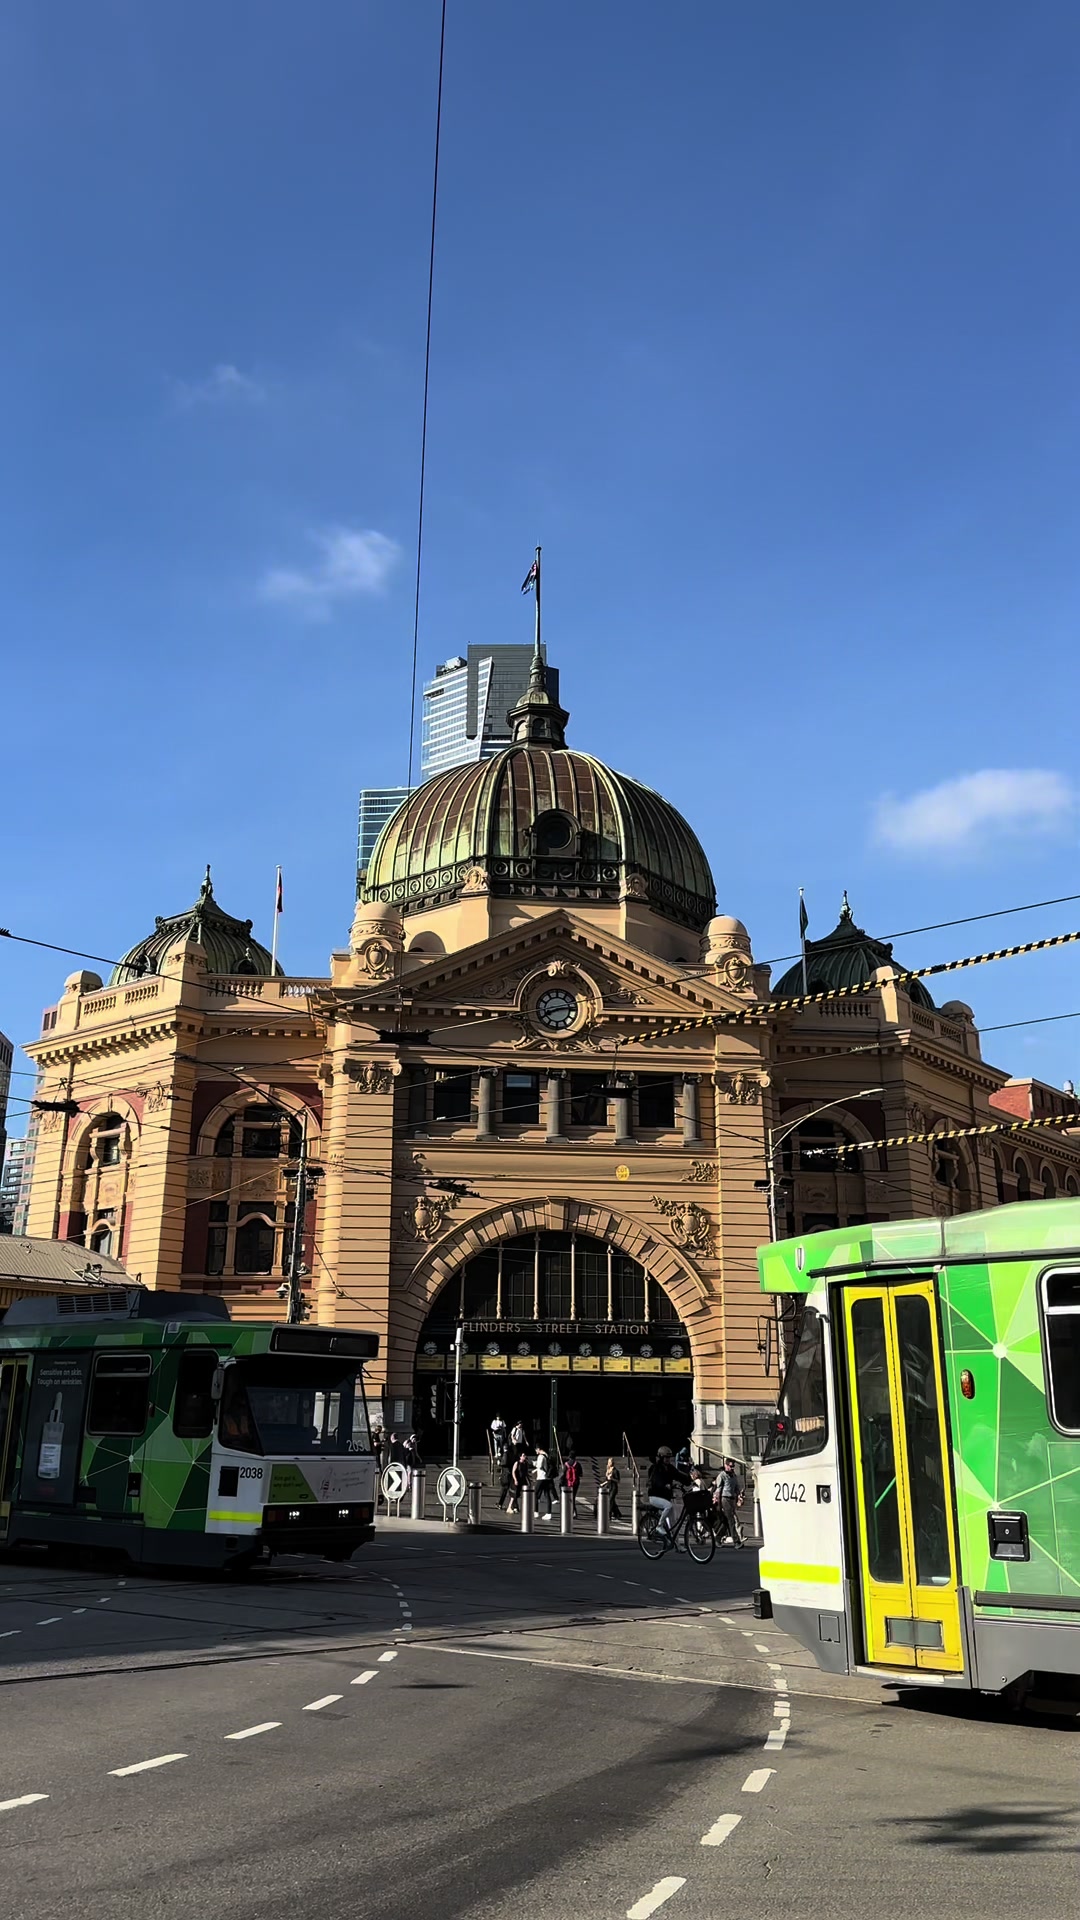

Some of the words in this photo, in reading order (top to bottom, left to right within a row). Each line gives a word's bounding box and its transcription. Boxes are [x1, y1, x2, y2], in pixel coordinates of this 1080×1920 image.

[461, 1322, 521, 1333] FLINDERS
[536, 1323, 581, 1334] STREET
[595, 1324, 650, 1335] STATION
[37, 1378, 53, 1387] Tough
[240, 1467, 264, 1479] 2038
[774, 1482, 806, 1503] 2042
